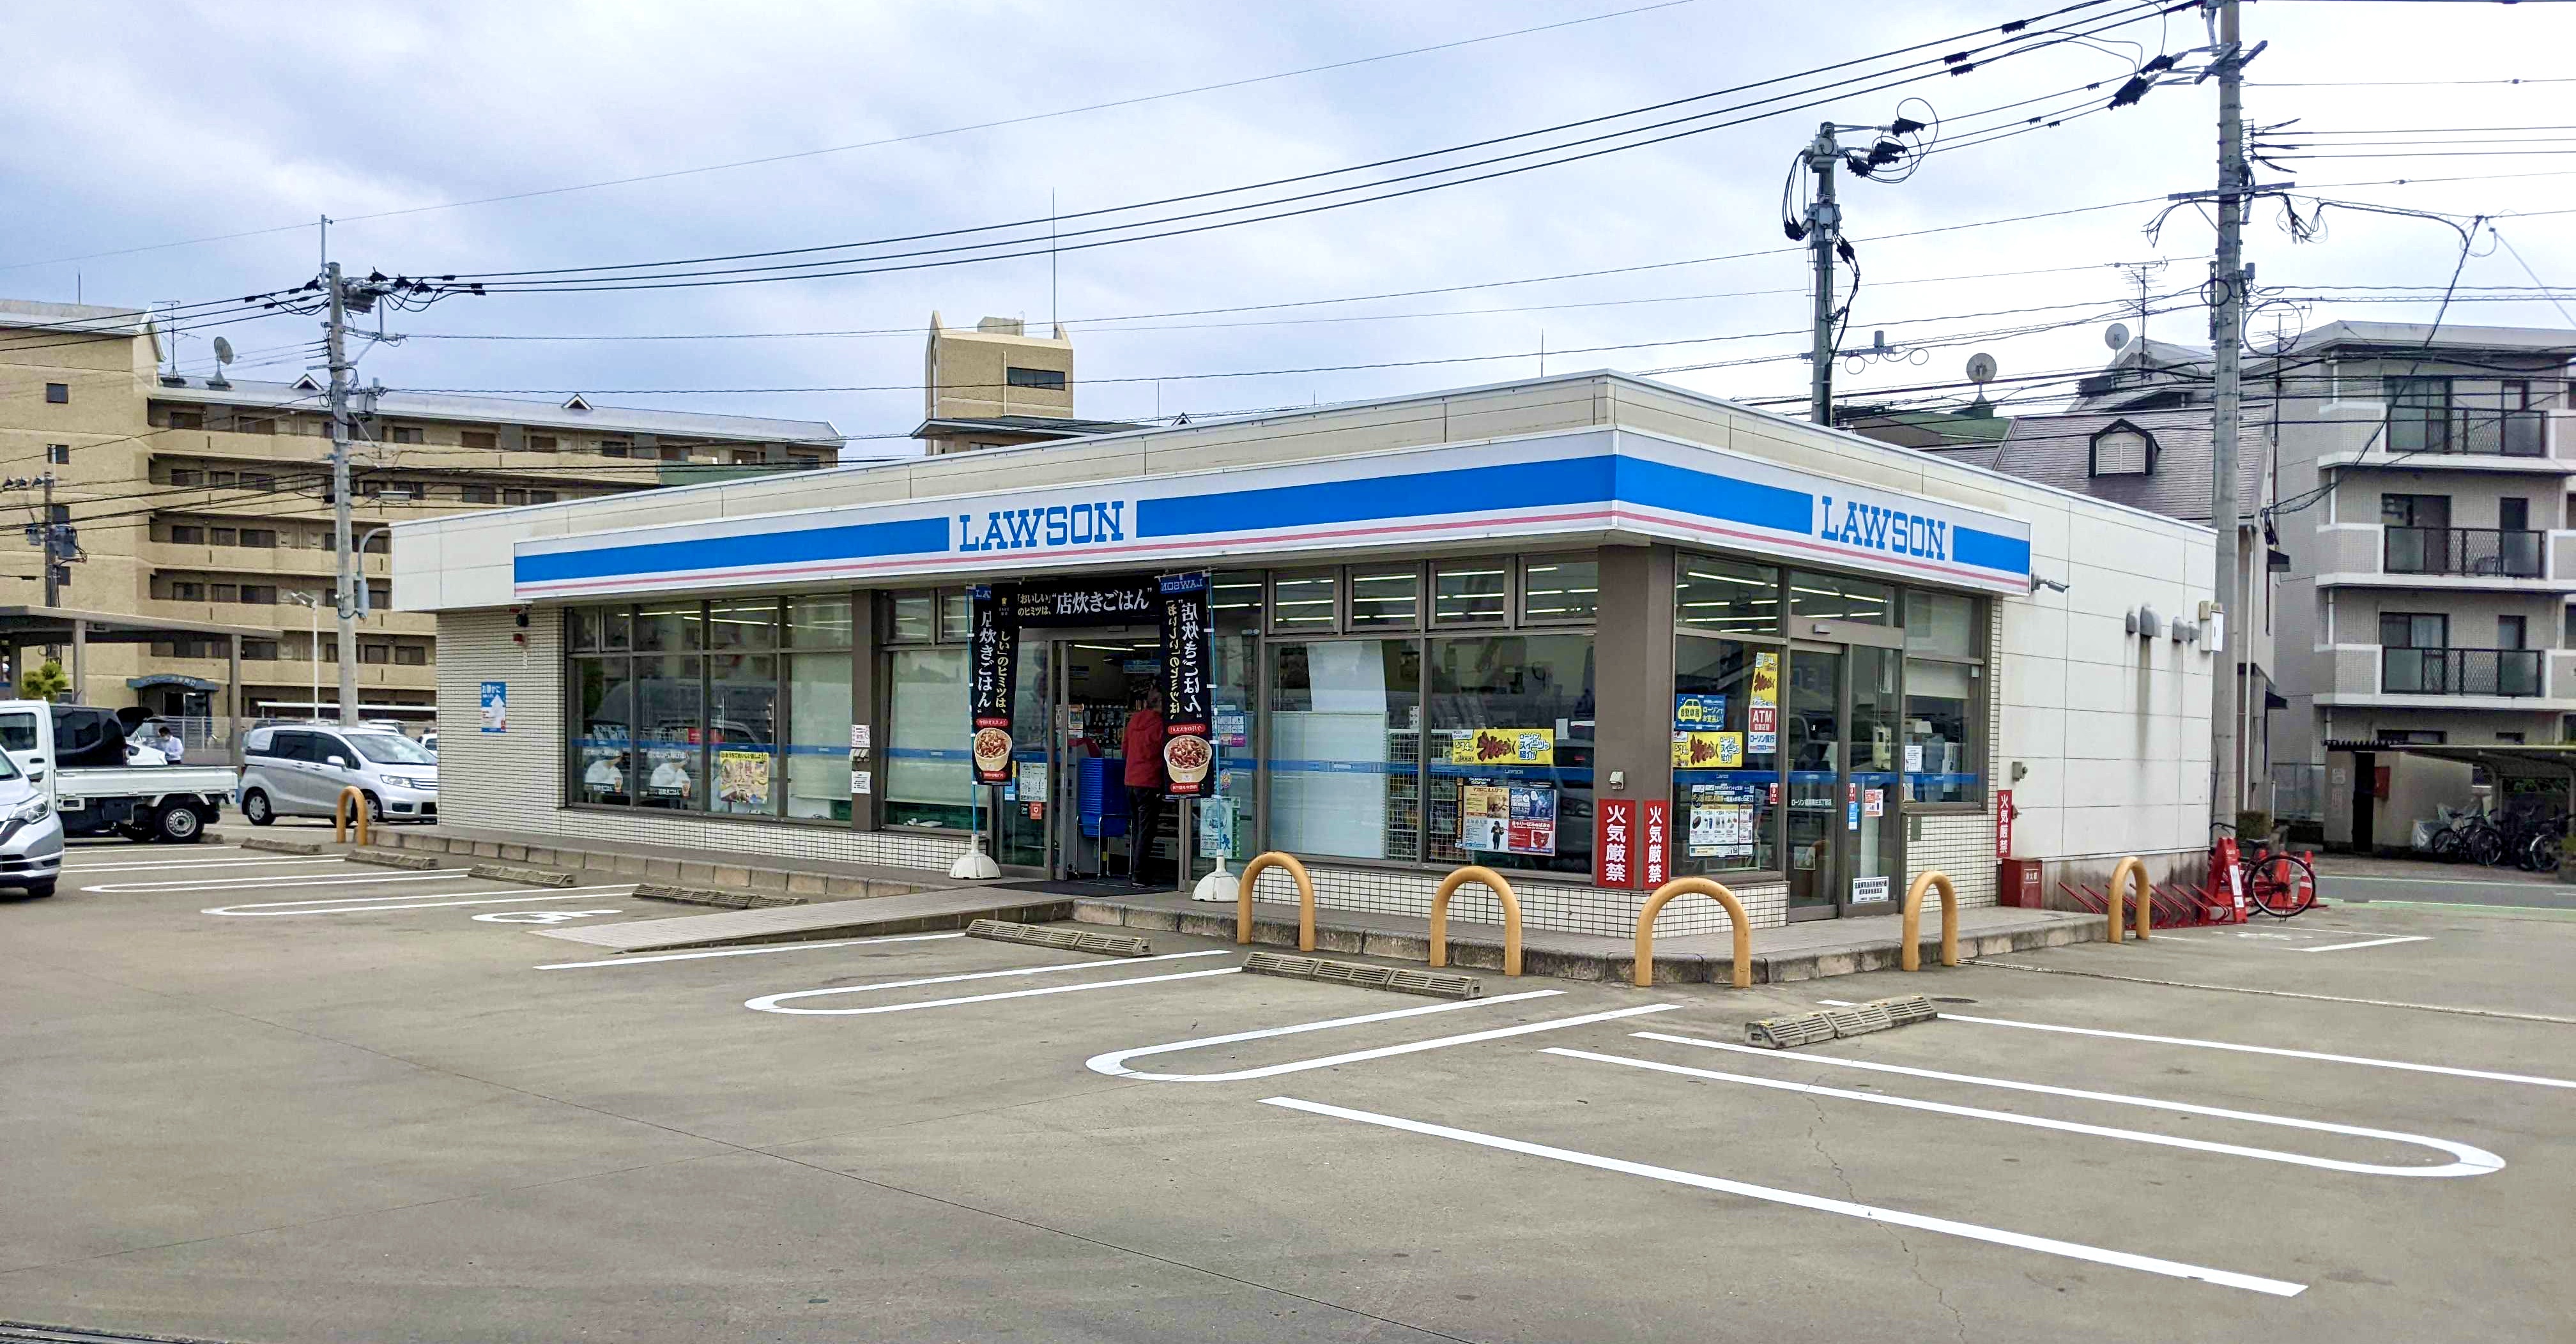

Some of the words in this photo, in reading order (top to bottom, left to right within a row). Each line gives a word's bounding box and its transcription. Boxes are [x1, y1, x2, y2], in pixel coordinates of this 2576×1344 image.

[960, 501, 1124, 552] LAWSON
[1821, 496, 1946, 561] LAWSON
[1752, 710, 1772, 723] ATM
[1606, 804, 1627, 882] 火気厳禁
[1648, 806, 1662, 883] 火気厳禁
[2000, 794, 2008, 853] 火気厳禁
